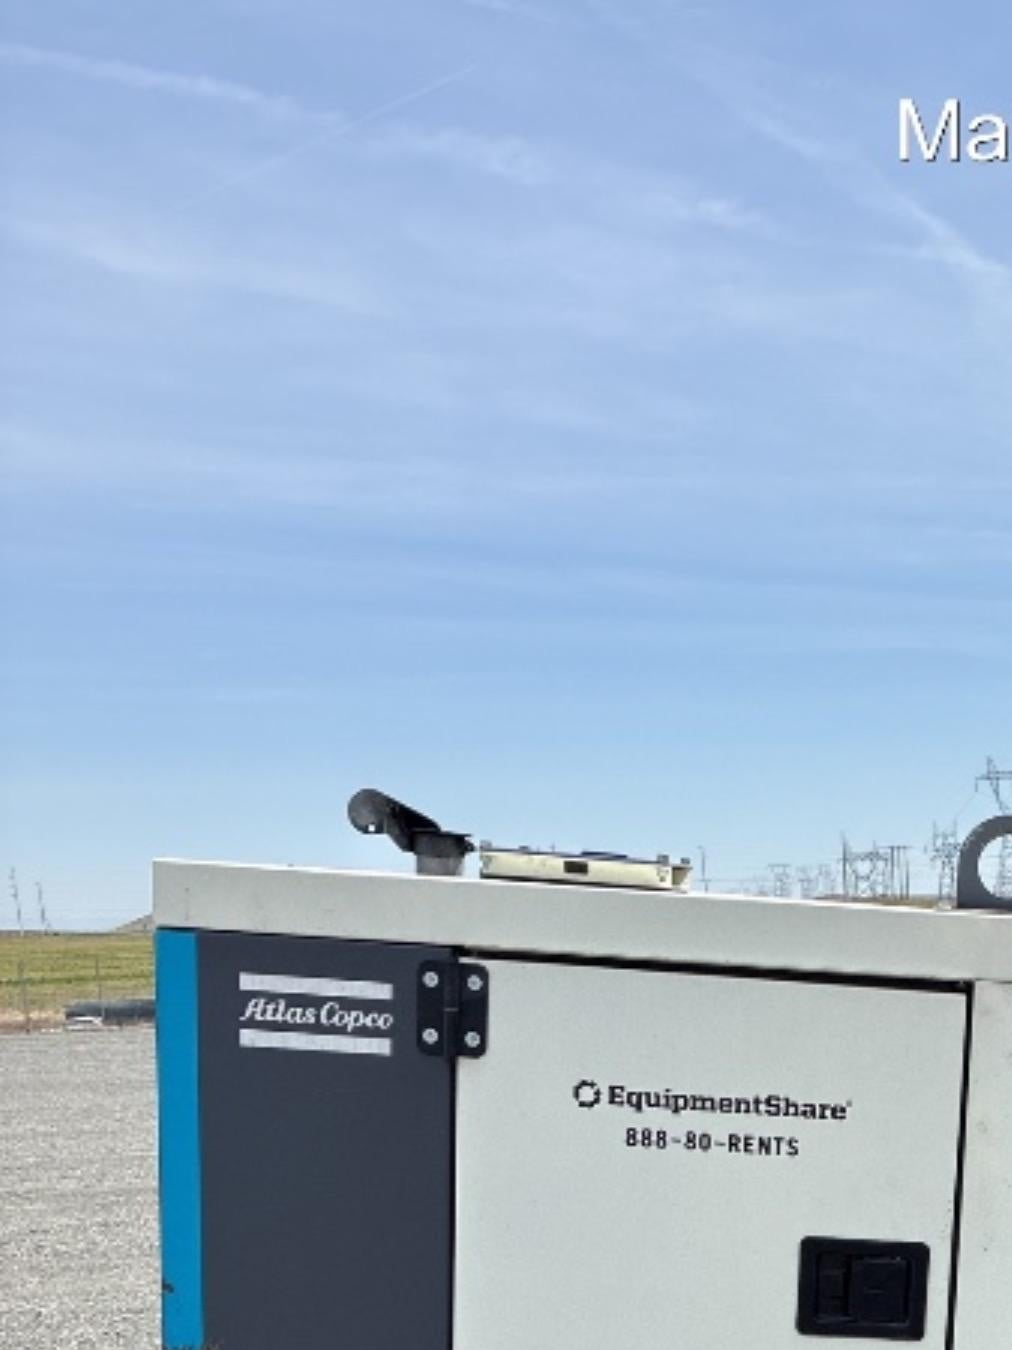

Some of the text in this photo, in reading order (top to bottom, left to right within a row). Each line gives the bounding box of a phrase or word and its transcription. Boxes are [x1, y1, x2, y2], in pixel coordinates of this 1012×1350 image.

[239, 998, 394, 1033] Atlas Copco
[607, 1084, 848, 1120] EquipmentShare
[625, 1127, 800, 1157] 888-80-RENTS
